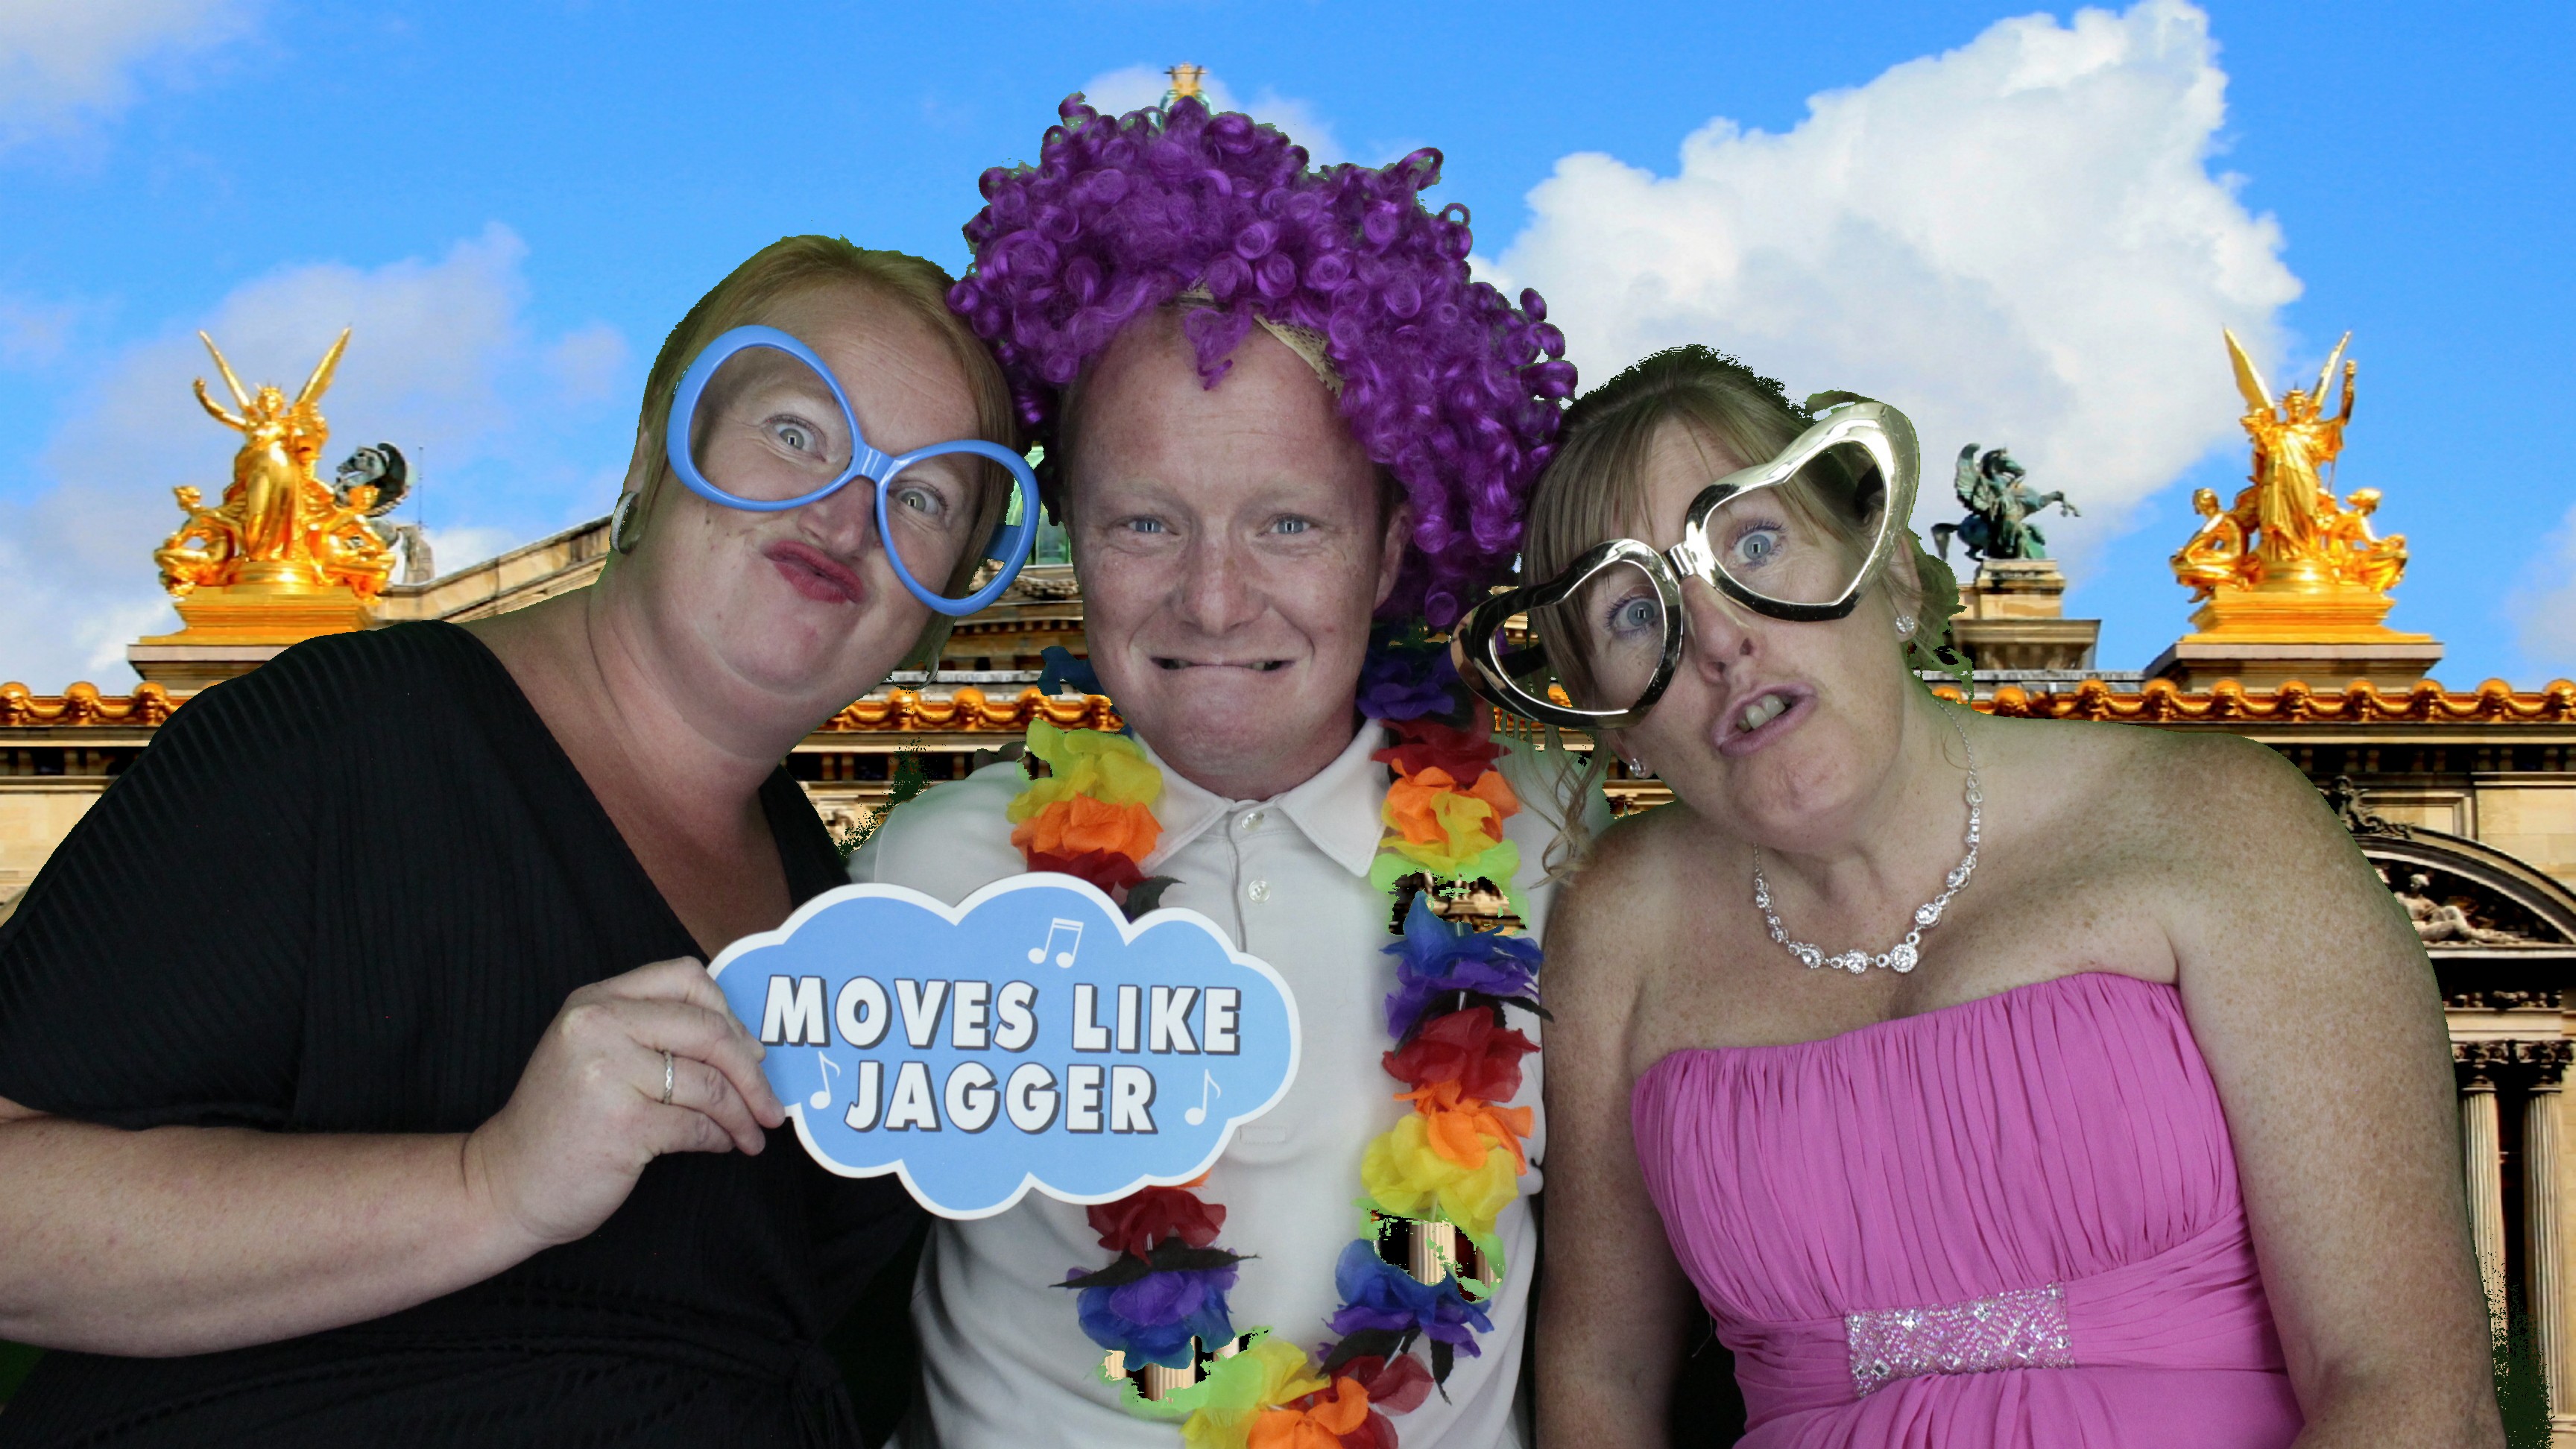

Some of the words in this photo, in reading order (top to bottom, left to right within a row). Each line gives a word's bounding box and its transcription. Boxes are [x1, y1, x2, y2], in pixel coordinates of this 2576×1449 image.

[760, 975, 1038, 1053] MOVES
[1072, 983, 1241, 1055] LIKE
[844, 1060, 1158, 1134] JAGGER
